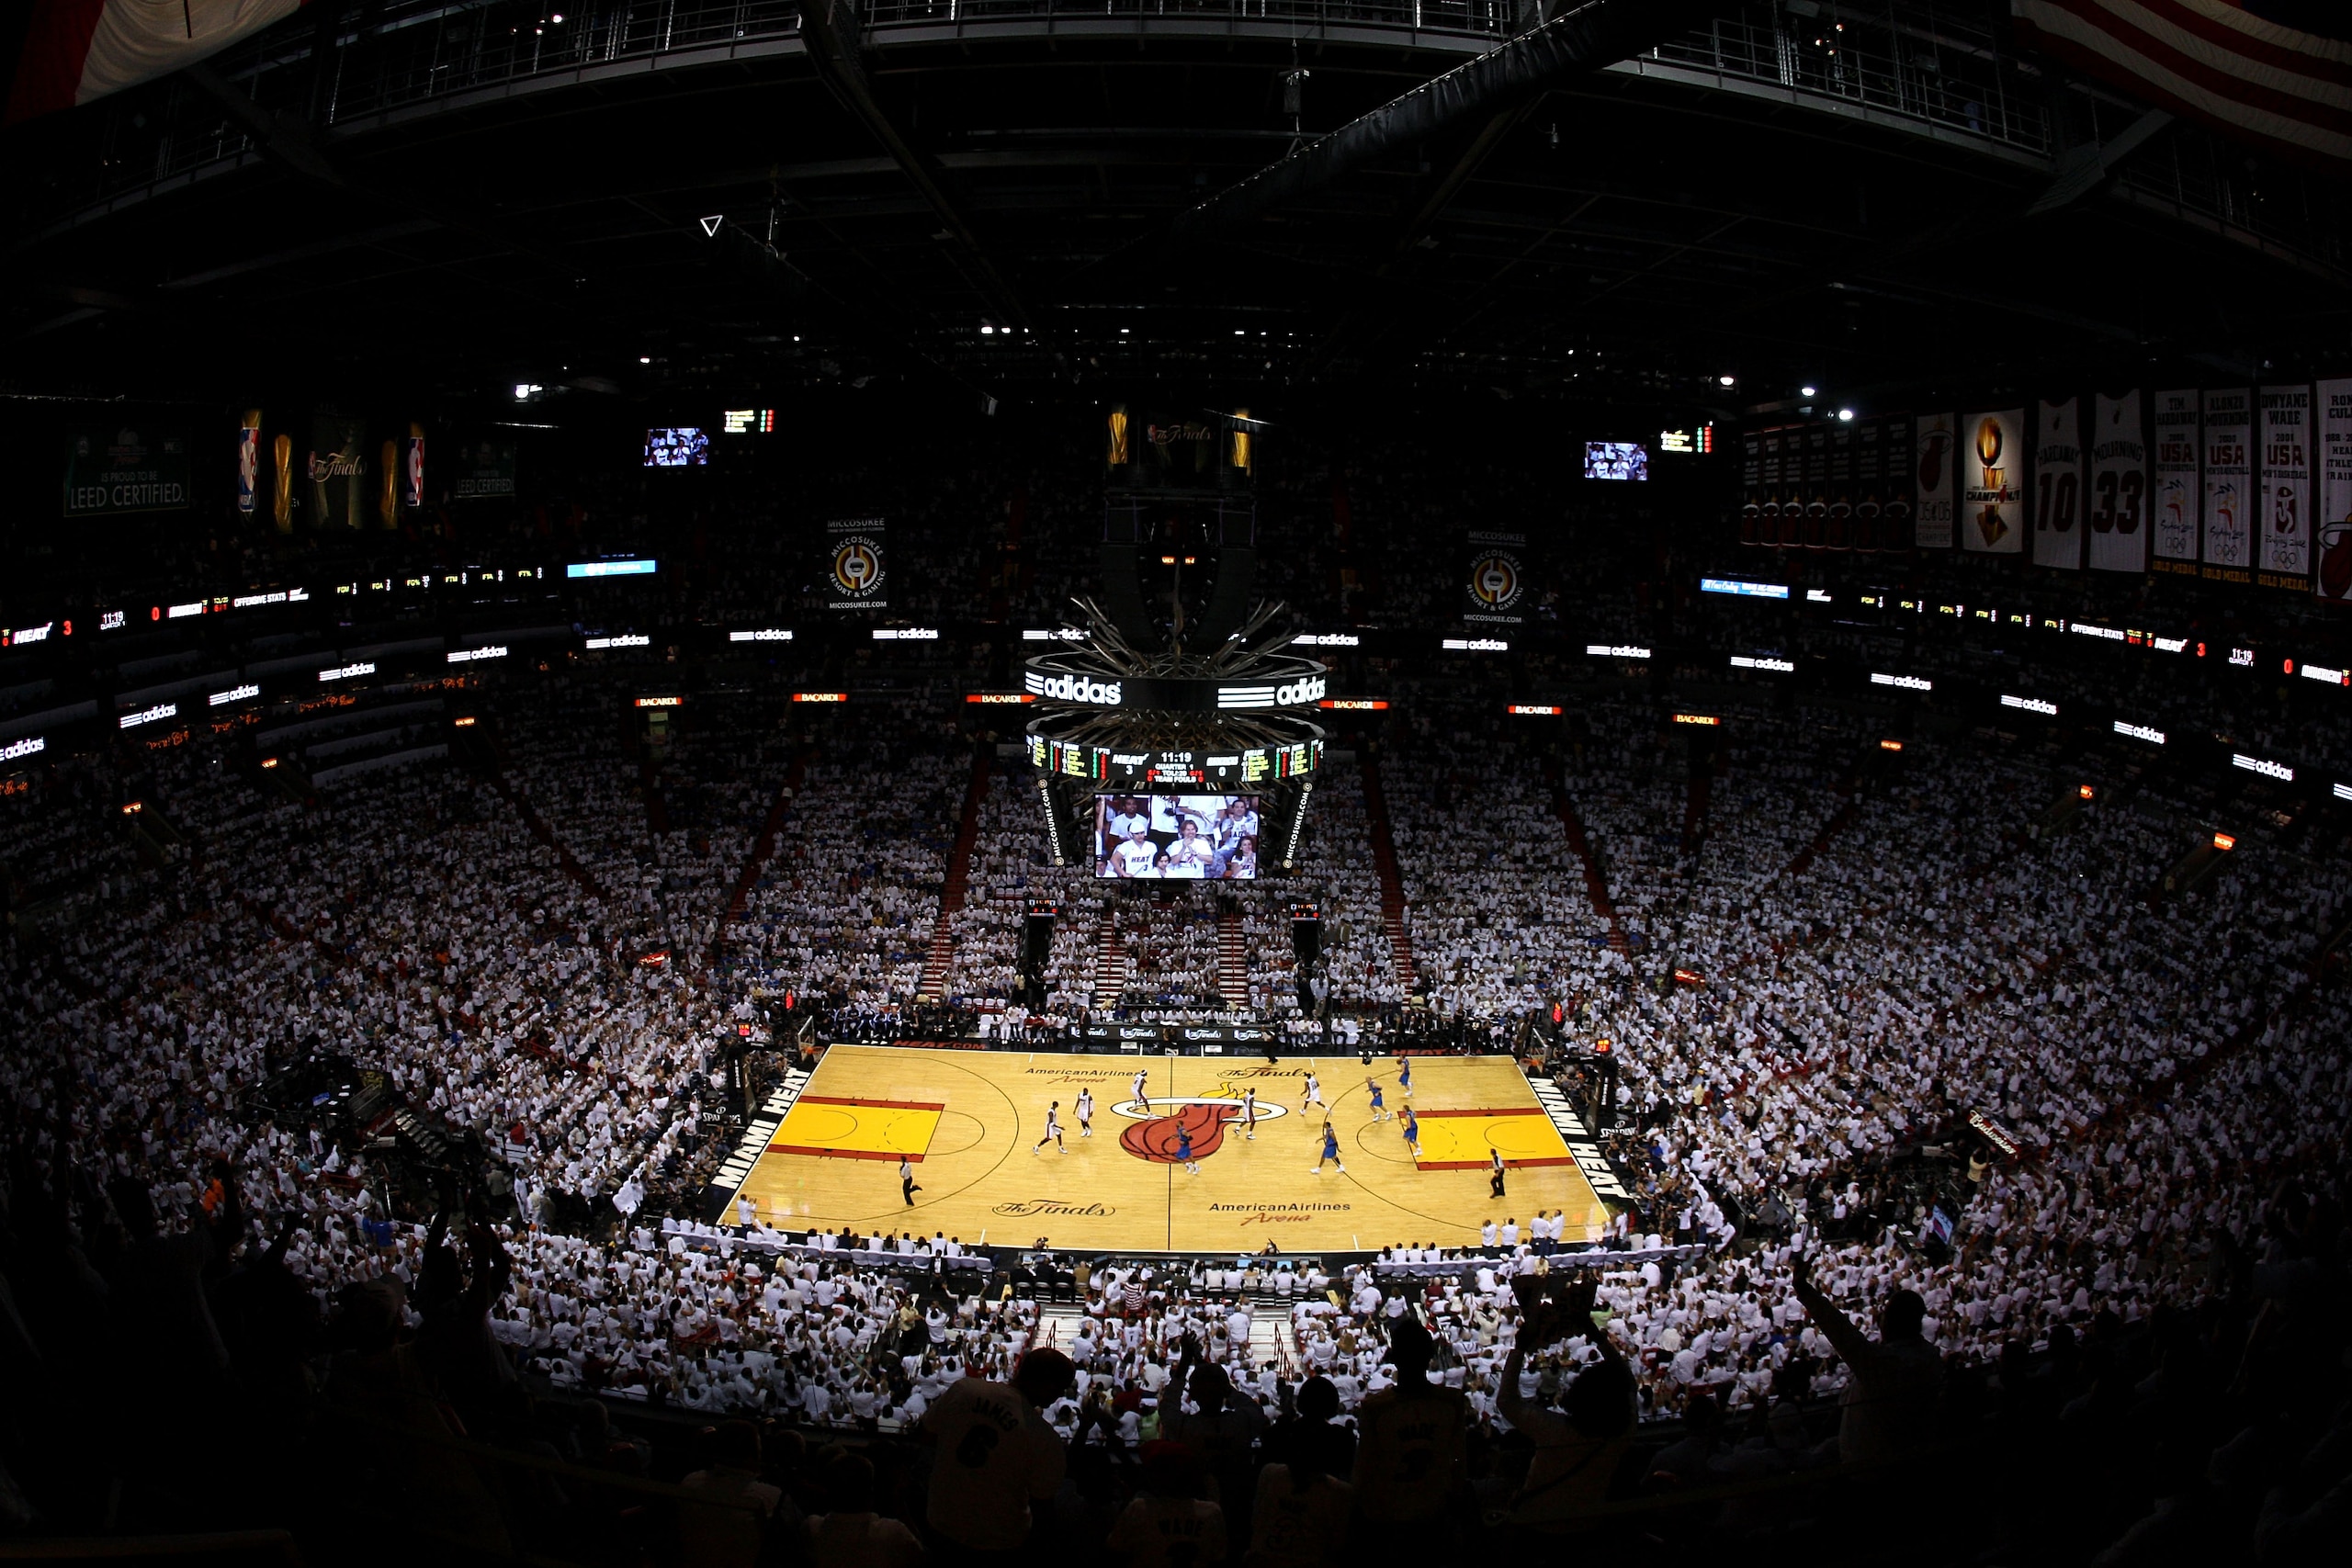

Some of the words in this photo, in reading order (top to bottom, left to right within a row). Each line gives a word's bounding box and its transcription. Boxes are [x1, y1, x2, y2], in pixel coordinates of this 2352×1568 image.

[2261, 394, 2308, 410] DWYANE
[2268, 410, 2301, 425] WADE
[2160, 444, 2194, 463] USA
[2210, 446, 2245, 465] USA
[2267, 445, 2303, 466] USA
[70, 487, 107, 509] LEED
[2038, 472, 2076, 532] 10
[2093, 470, 2143, 534] 33
[827, 517, 886, 528] MICCOSUKEE
[1467, 530, 1527, 542] MICCOSUKEE
[831, 536, 884, 558] MICCOSUKEE
[1470, 549, 1524, 573] MICCOSUKEE
[829, 572, 852, 597] RESORT
[862, 570, 886, 597] GAMING
[2257, 572, 2278, 588] GOLD
[2278, 576, 2309, 592] MEDAL
[234, 594, 266, 607] OFFENSIVE
[267, 592, 287, 603] STATS
[829, 601, 888, 610] MICCOSUKEE.COM
[1498, 587, 1523, 611] GAMING
[102, 611, 124, 625] 11:19
[152, 606, 160, 621] 0
[1463, 614, 1523, 624] MICCOSUKEE.COM
[13, 622, 53, 645] HEAT
[63, 620, 73, 636] 3
[756, 629, 794, 641] adidas
[899, 629, 939, 639] adidas
[2071, 624, 2103, 637] OFFENSIVE
[2103, 628, 2124, 640] STATS
[611, 634, 650, 648] adidas
[1317, 634, 1360, 646] adidas
[1467, 639, 1508, 650] adidas
[2154, 637, 2188, 652] HEAT
[471, 646, 508, 660] adidas
[1610, 646, 1651, 658] adidas
[2197, 642, 2206, 657] 3
[2233, 649, 2253, 661] 11:19
[341, 662, 376, 679] adidas
[1755, 658, 1794, 671] adidas
[2284, 659, 2293, 673] 0
[1044, 674, 1123, 706] adidas
[1894, 676, 1932, 691] adidas
[229, 683, 260, 701] adidas
[802, 694, 839, 703] BACARDI
[982, 694, 1021, 704] BACARDI
[639, 697, 677, 706] BACARDI
[1333, 700, 1374, 709] BACARDI
[2022, 698, 2057, 715] adidas
[142, 704, 177, 724] adidas
[1515, 705, 1553, 715] BACARDI
[1676, 715, 1714, 725] BACARDI
[2132, 726, 2165, 745] adidas
[4, 738, 46, 761] adidas
[1160, 751, 1193, 762] 11:19
[1113, 753, 1149, 766] HEAT
[1125, 764, 1134, 776] 3
[1218, 766, 1227, 777] 0
[2255, 760, 2294, 782] adidas
[1040, 788, 1062, 858] MICCOSUKEE.COM
[1285, 792, 1311, 861] MICCOSUKEE.COM
[1046, 1074, 1108, 1085] Arena
[762, 1066, 810, 1116] HEAT
[1528, 1077, 1589, 1136] MIAMI
[1567, 1143, 1635, 1200] HEAT
[711, 1119, 779, 1190] MIAMI
[995, 1202, 1031, 1213] The
[1013, 1199, 1115, 1218] Finals
[1208, 1202, 1351, 1212] AmericanAirlines
[1239, 1212, 1312, 1226] Arena
[972, 1396, 1019, 1432] JAMES
[957, 1424, 999, 1469] 6
